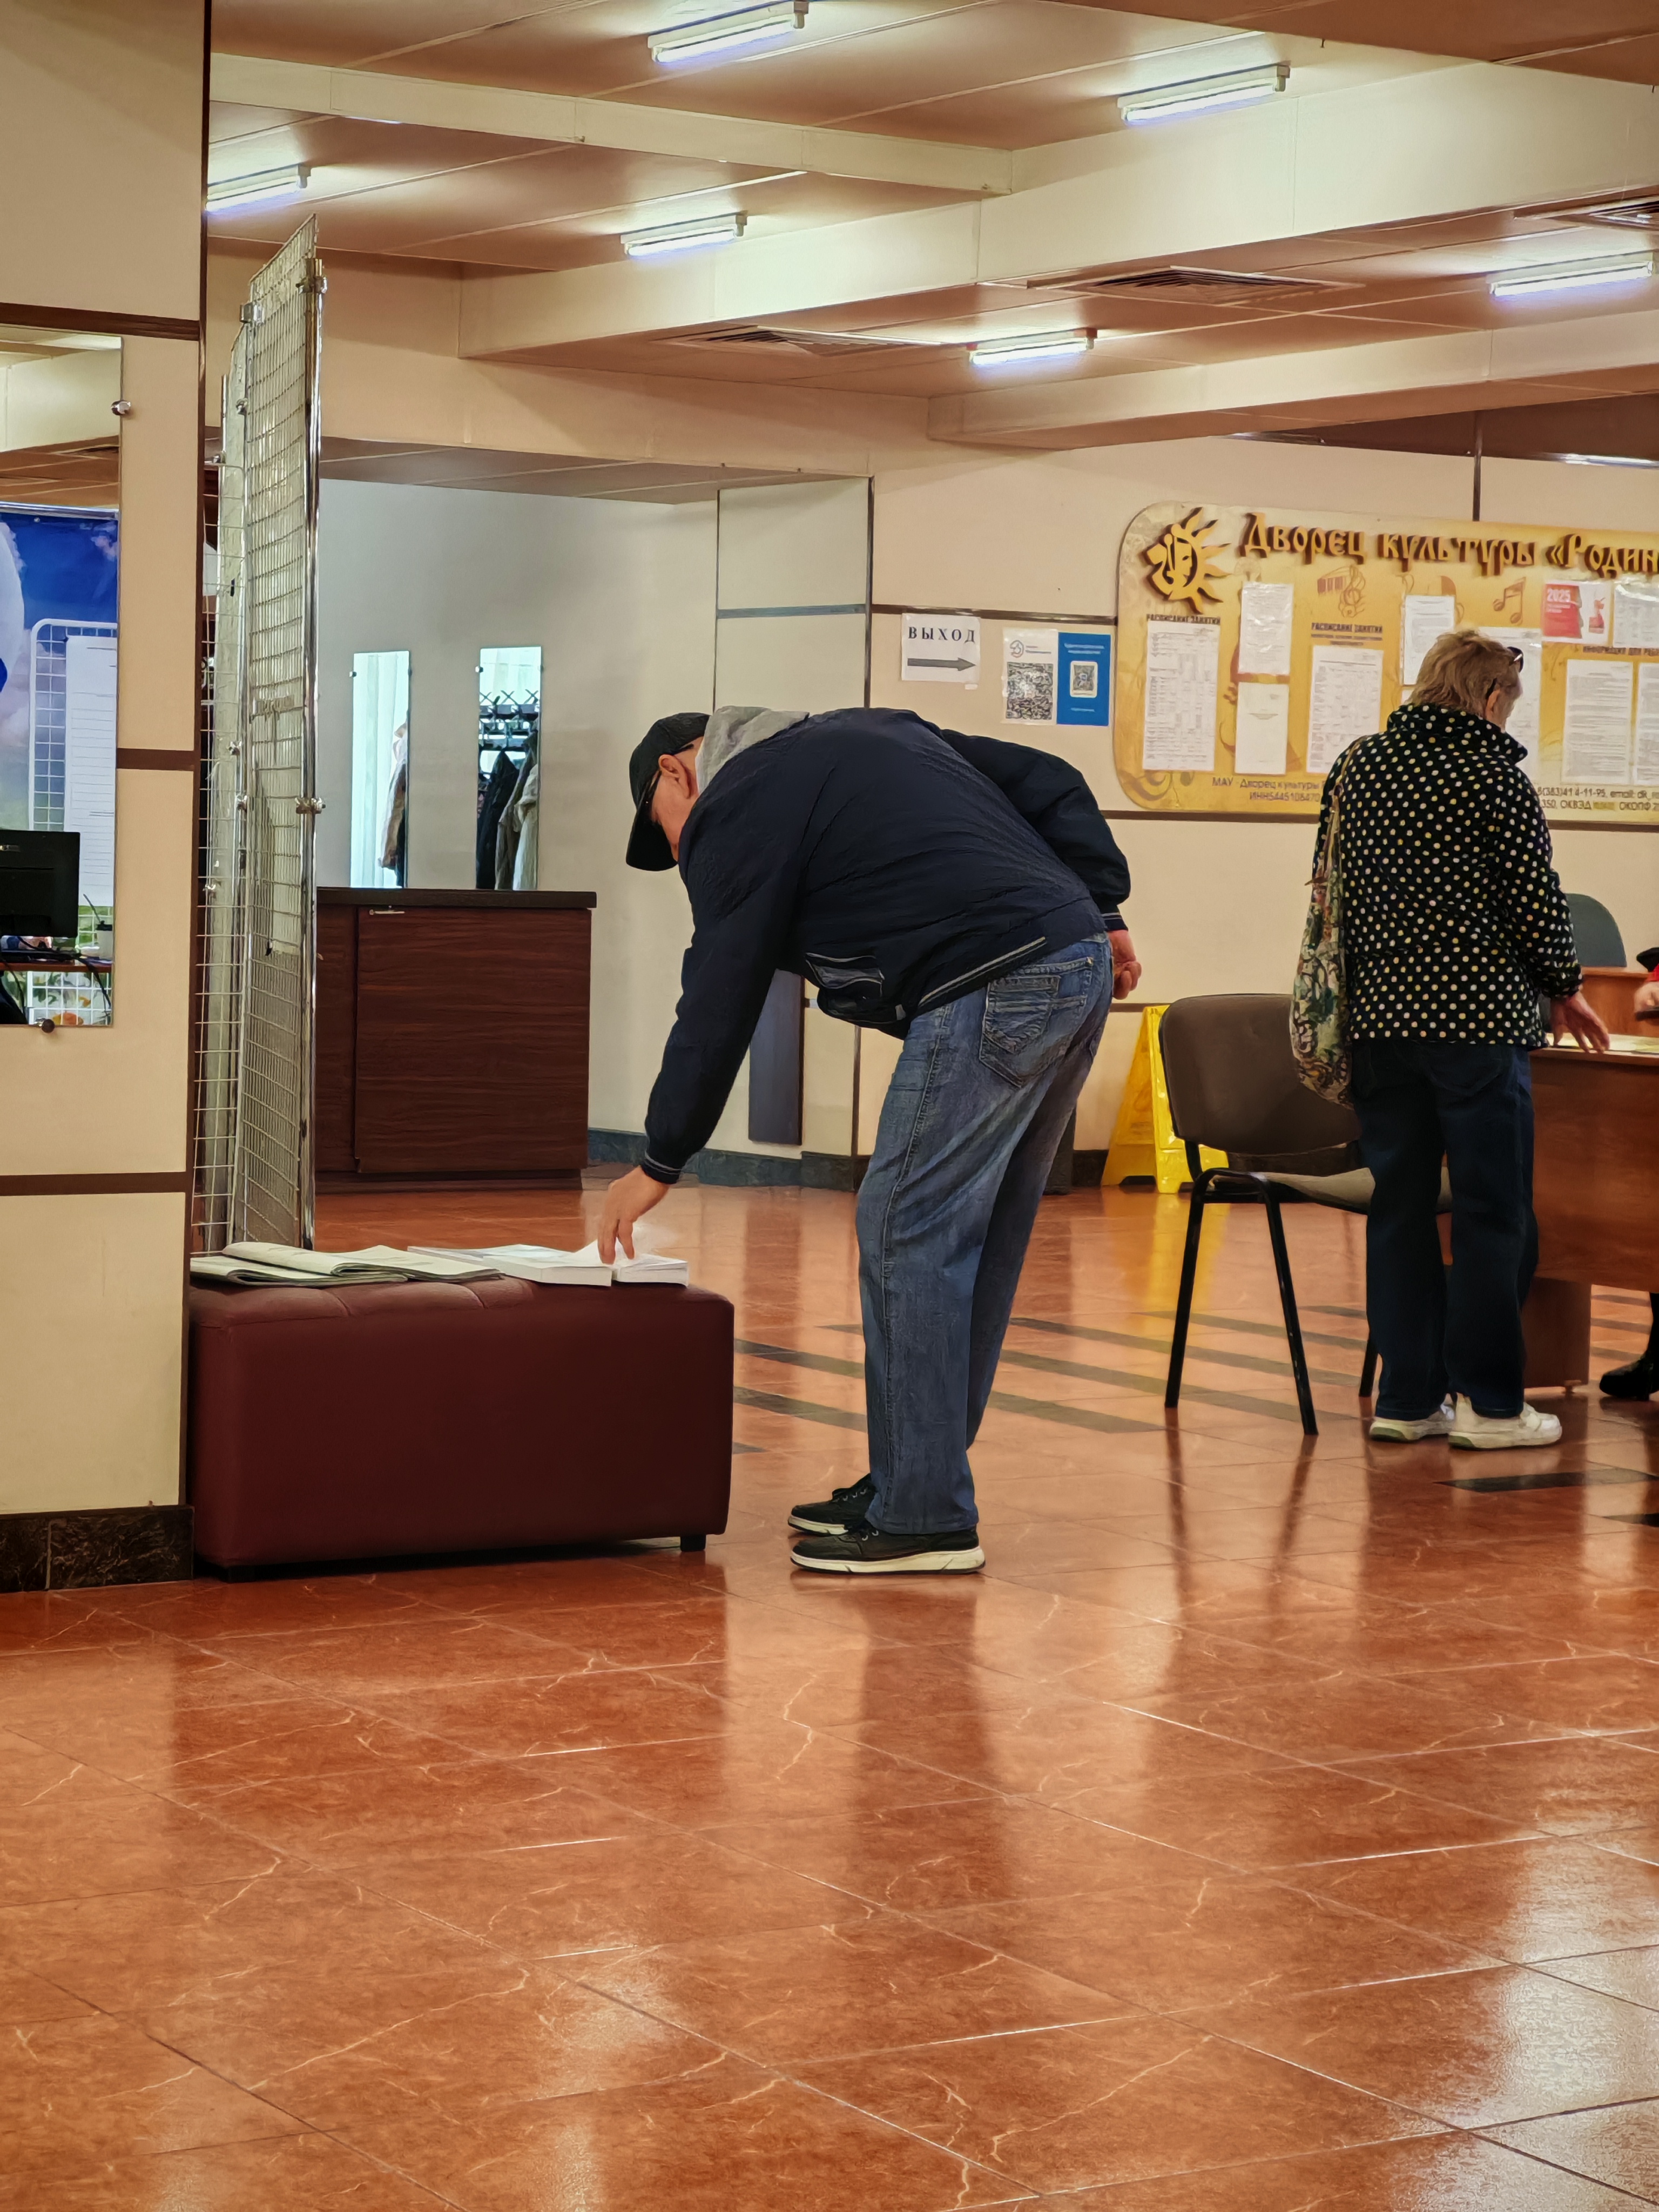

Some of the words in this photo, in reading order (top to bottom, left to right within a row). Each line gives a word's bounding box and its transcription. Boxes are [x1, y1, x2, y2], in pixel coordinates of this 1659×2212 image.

[1238, 512, 1368, 565] Дворец
[1376, 532, 1536, 576] культуры
[1546, 534, 1659, 579] «Родин
[1547, 588, 1571, 602] 2025
[908, 626, 975, 644] ВЫХОД
[1212, 777, 1233, 786] МАУ
